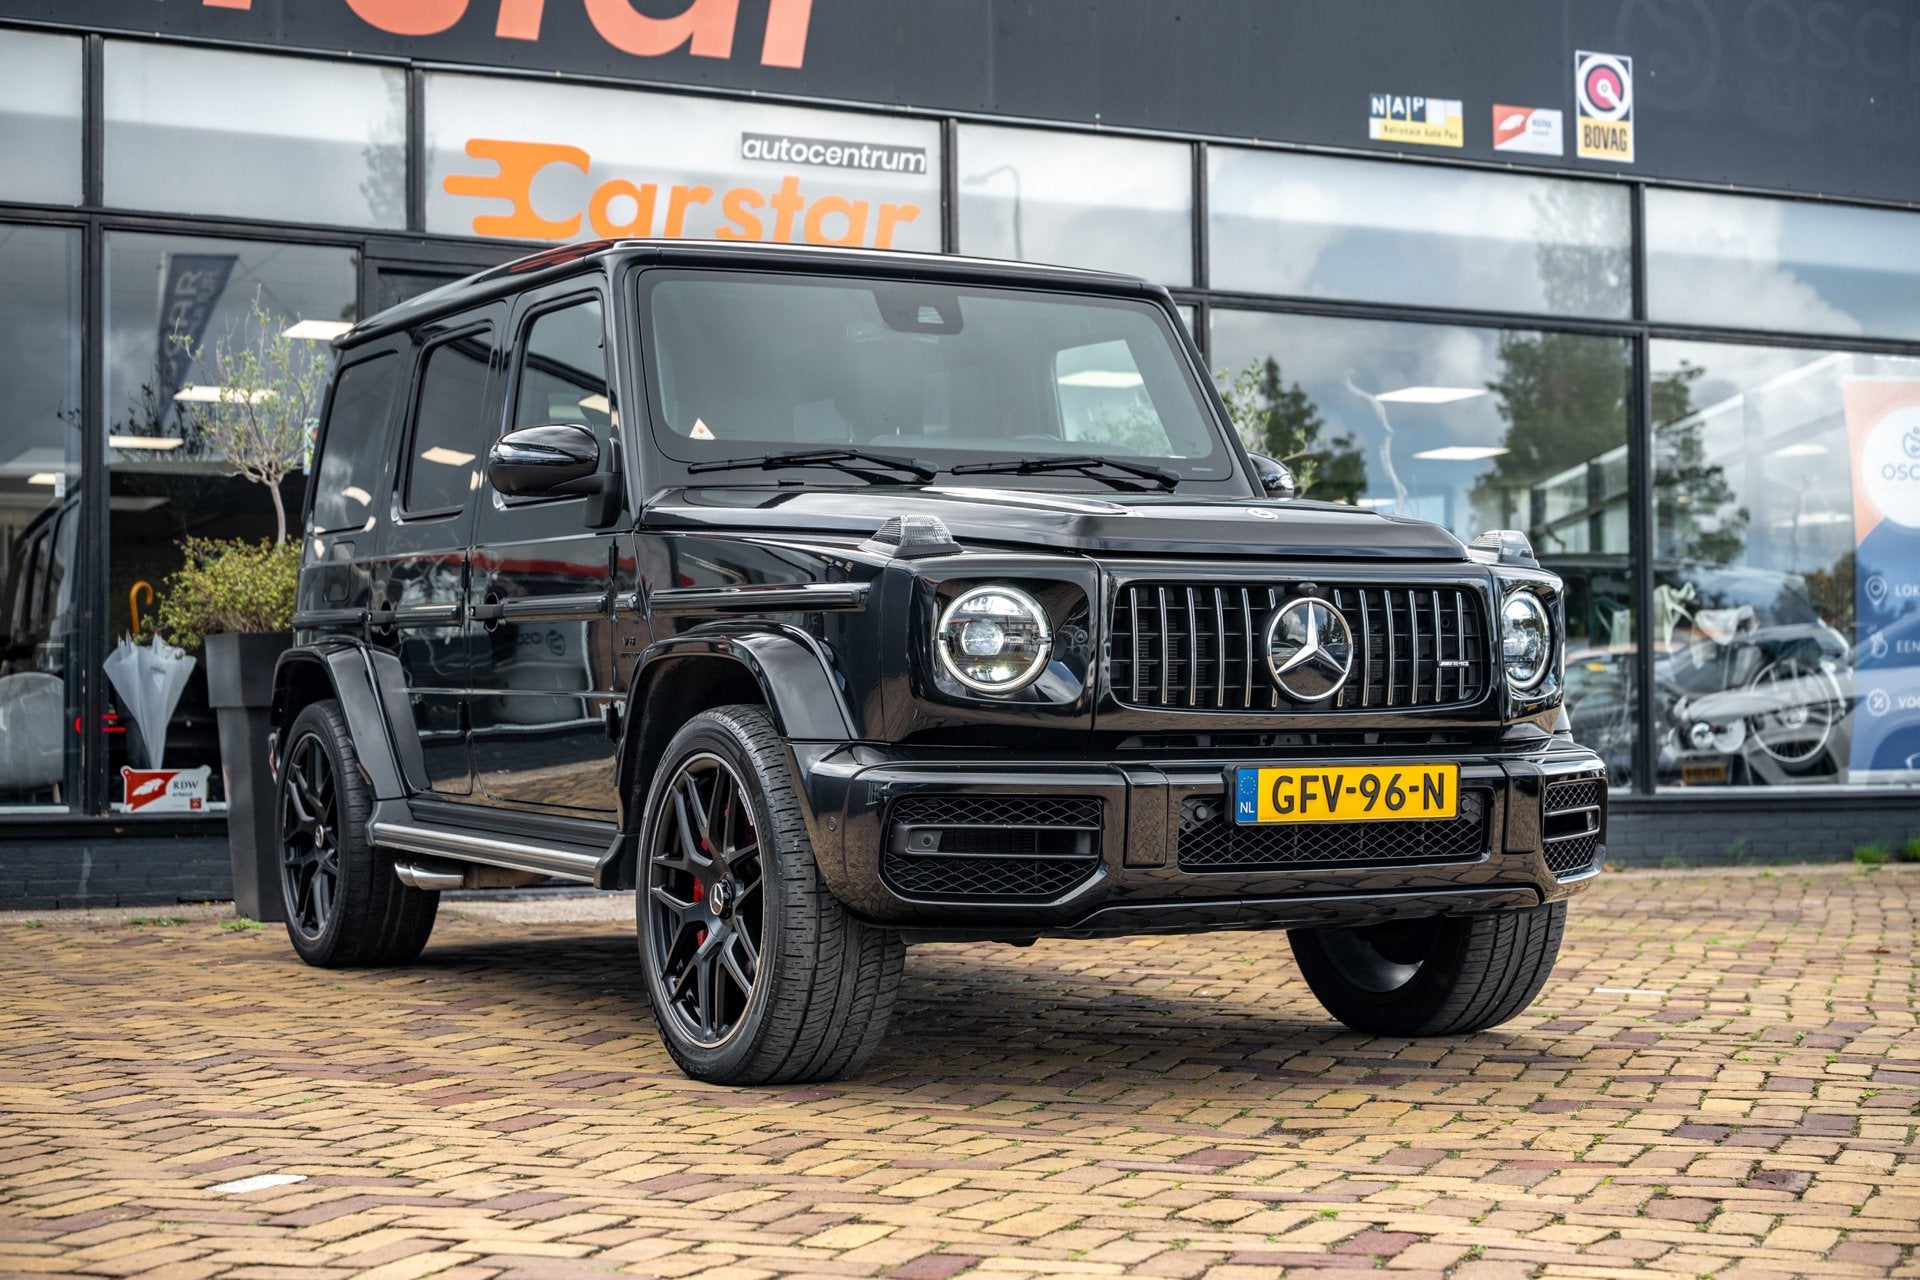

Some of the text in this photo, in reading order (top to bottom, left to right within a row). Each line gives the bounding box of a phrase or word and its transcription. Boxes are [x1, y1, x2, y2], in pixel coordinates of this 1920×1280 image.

[1744, 0, 1920, 82] OSC
[1746, 77, 1920, 126] AUTOVER
[742, 137, 927, 173] autocentrum
[1583, 124, 1628, 152] BOVAG
[442, 138, 922, 249] Carstar
[173, 781, 199, 790] RDW
[1272, 773, 1445, 814] GFV-96-N
[1240, 801, 1255, 814] NL
